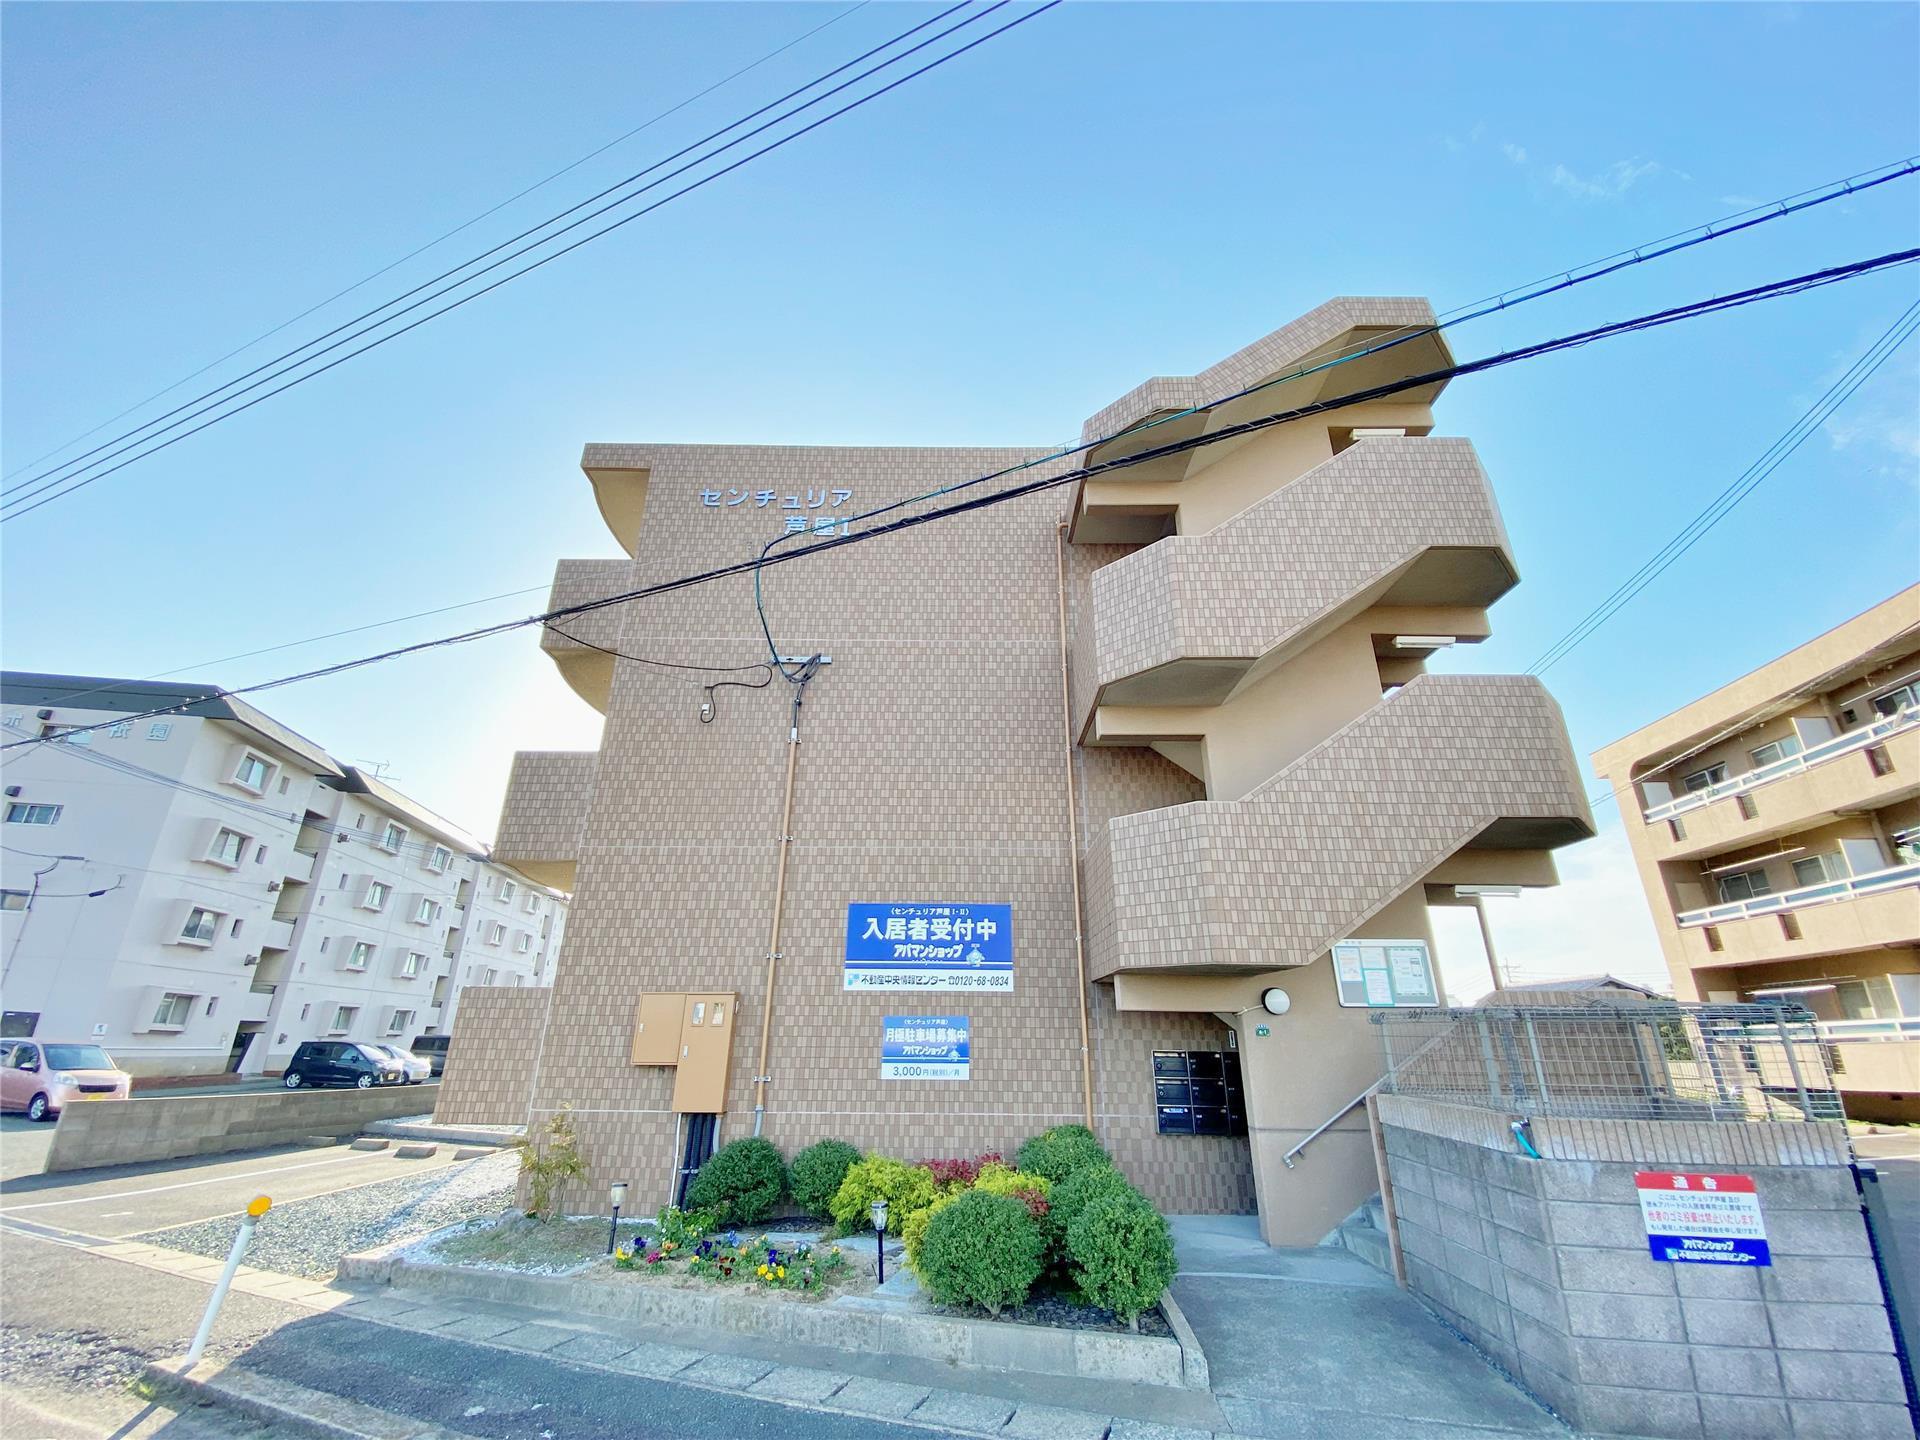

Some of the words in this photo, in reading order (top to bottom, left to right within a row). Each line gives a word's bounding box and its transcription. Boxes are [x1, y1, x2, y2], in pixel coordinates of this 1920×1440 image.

[700, 488, 853, 510] センチュリア
[862, 917, 997, 941] 入居者受付中
[893, 943, 964, 958] アパマンショップ
[861, 974, 946, 986] 不動産中央情報センター
[886, 1027, 967, 1043] 月極駐車場募集中
[902, 1045, 948, 1056] アパマンショップ
